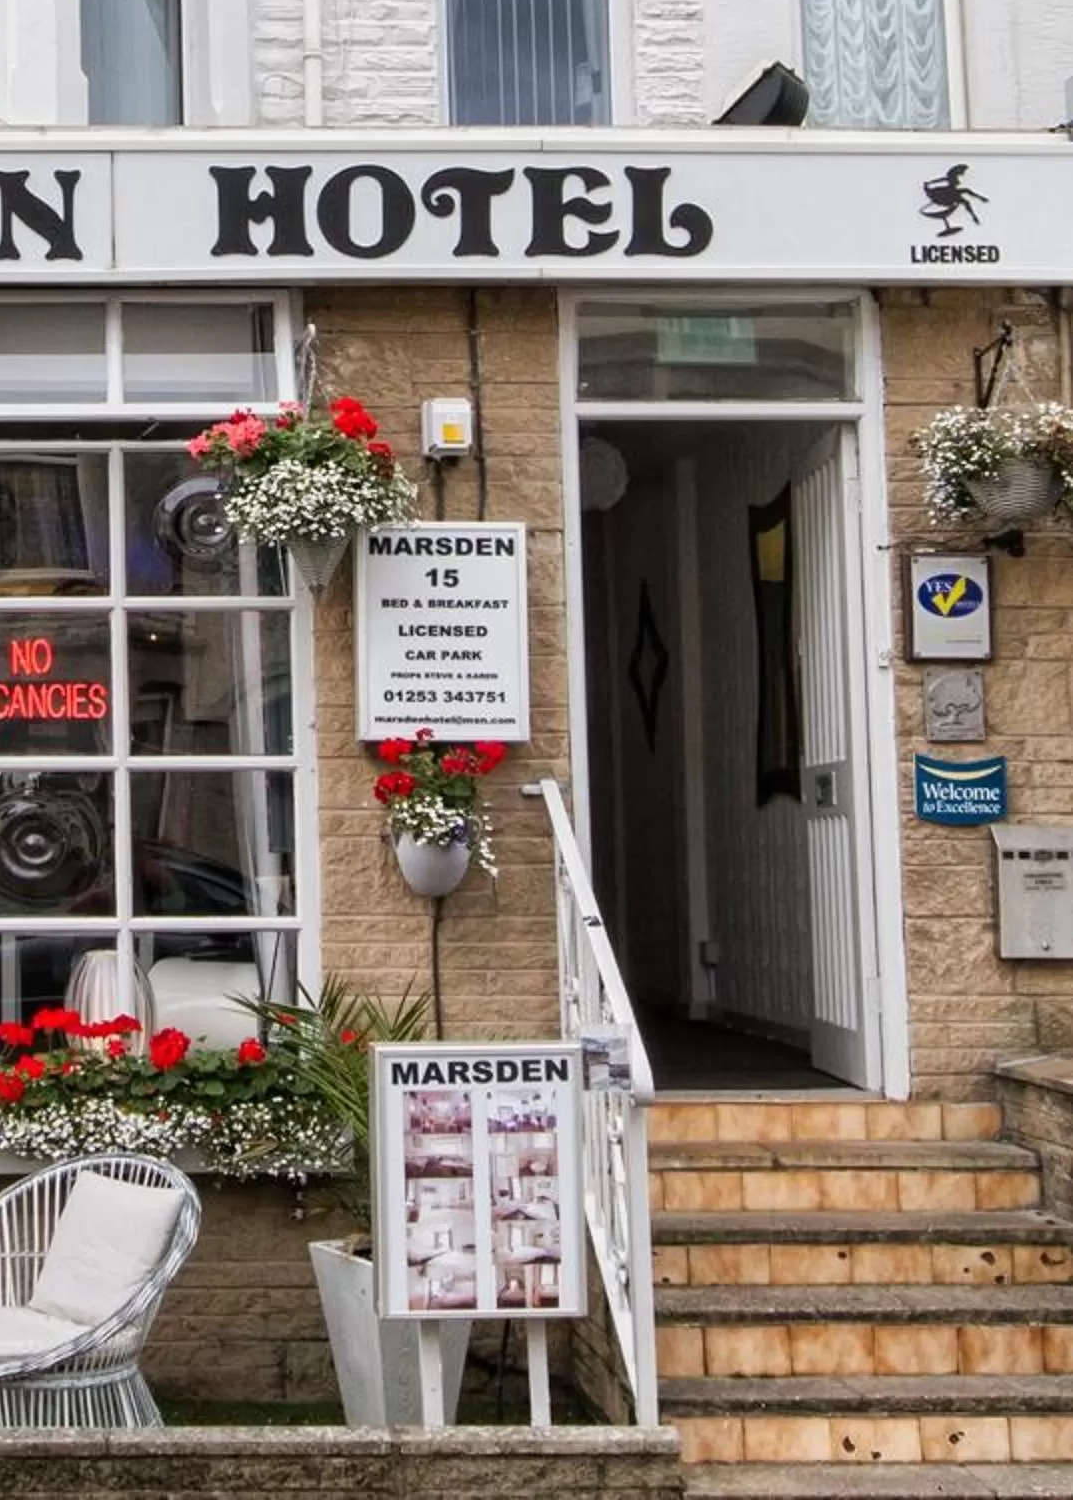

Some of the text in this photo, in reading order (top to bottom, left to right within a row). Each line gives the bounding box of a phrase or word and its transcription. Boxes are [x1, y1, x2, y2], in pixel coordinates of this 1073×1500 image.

[209, 164, 714, 259] HOTEL
[911, 245, 1001, 264] LICENSED
[368, 536, 515, 557] MARSDEN
[425, 568, 460, 588] 15
[381, 598, 509, 610] BED & BREAKFAST
[398, 624, 488, 638] LICENSED
[8, 637, 54, 676] NO
[405, 650, 483, 661] CAR PARK
[383, 690, 506, 703] 01253 343751
[922, 781, 1001, 801] Welcome
[922, 800, 1002, 814] to Excellence
[391, 1059, 569, 1085] MARSDEN
